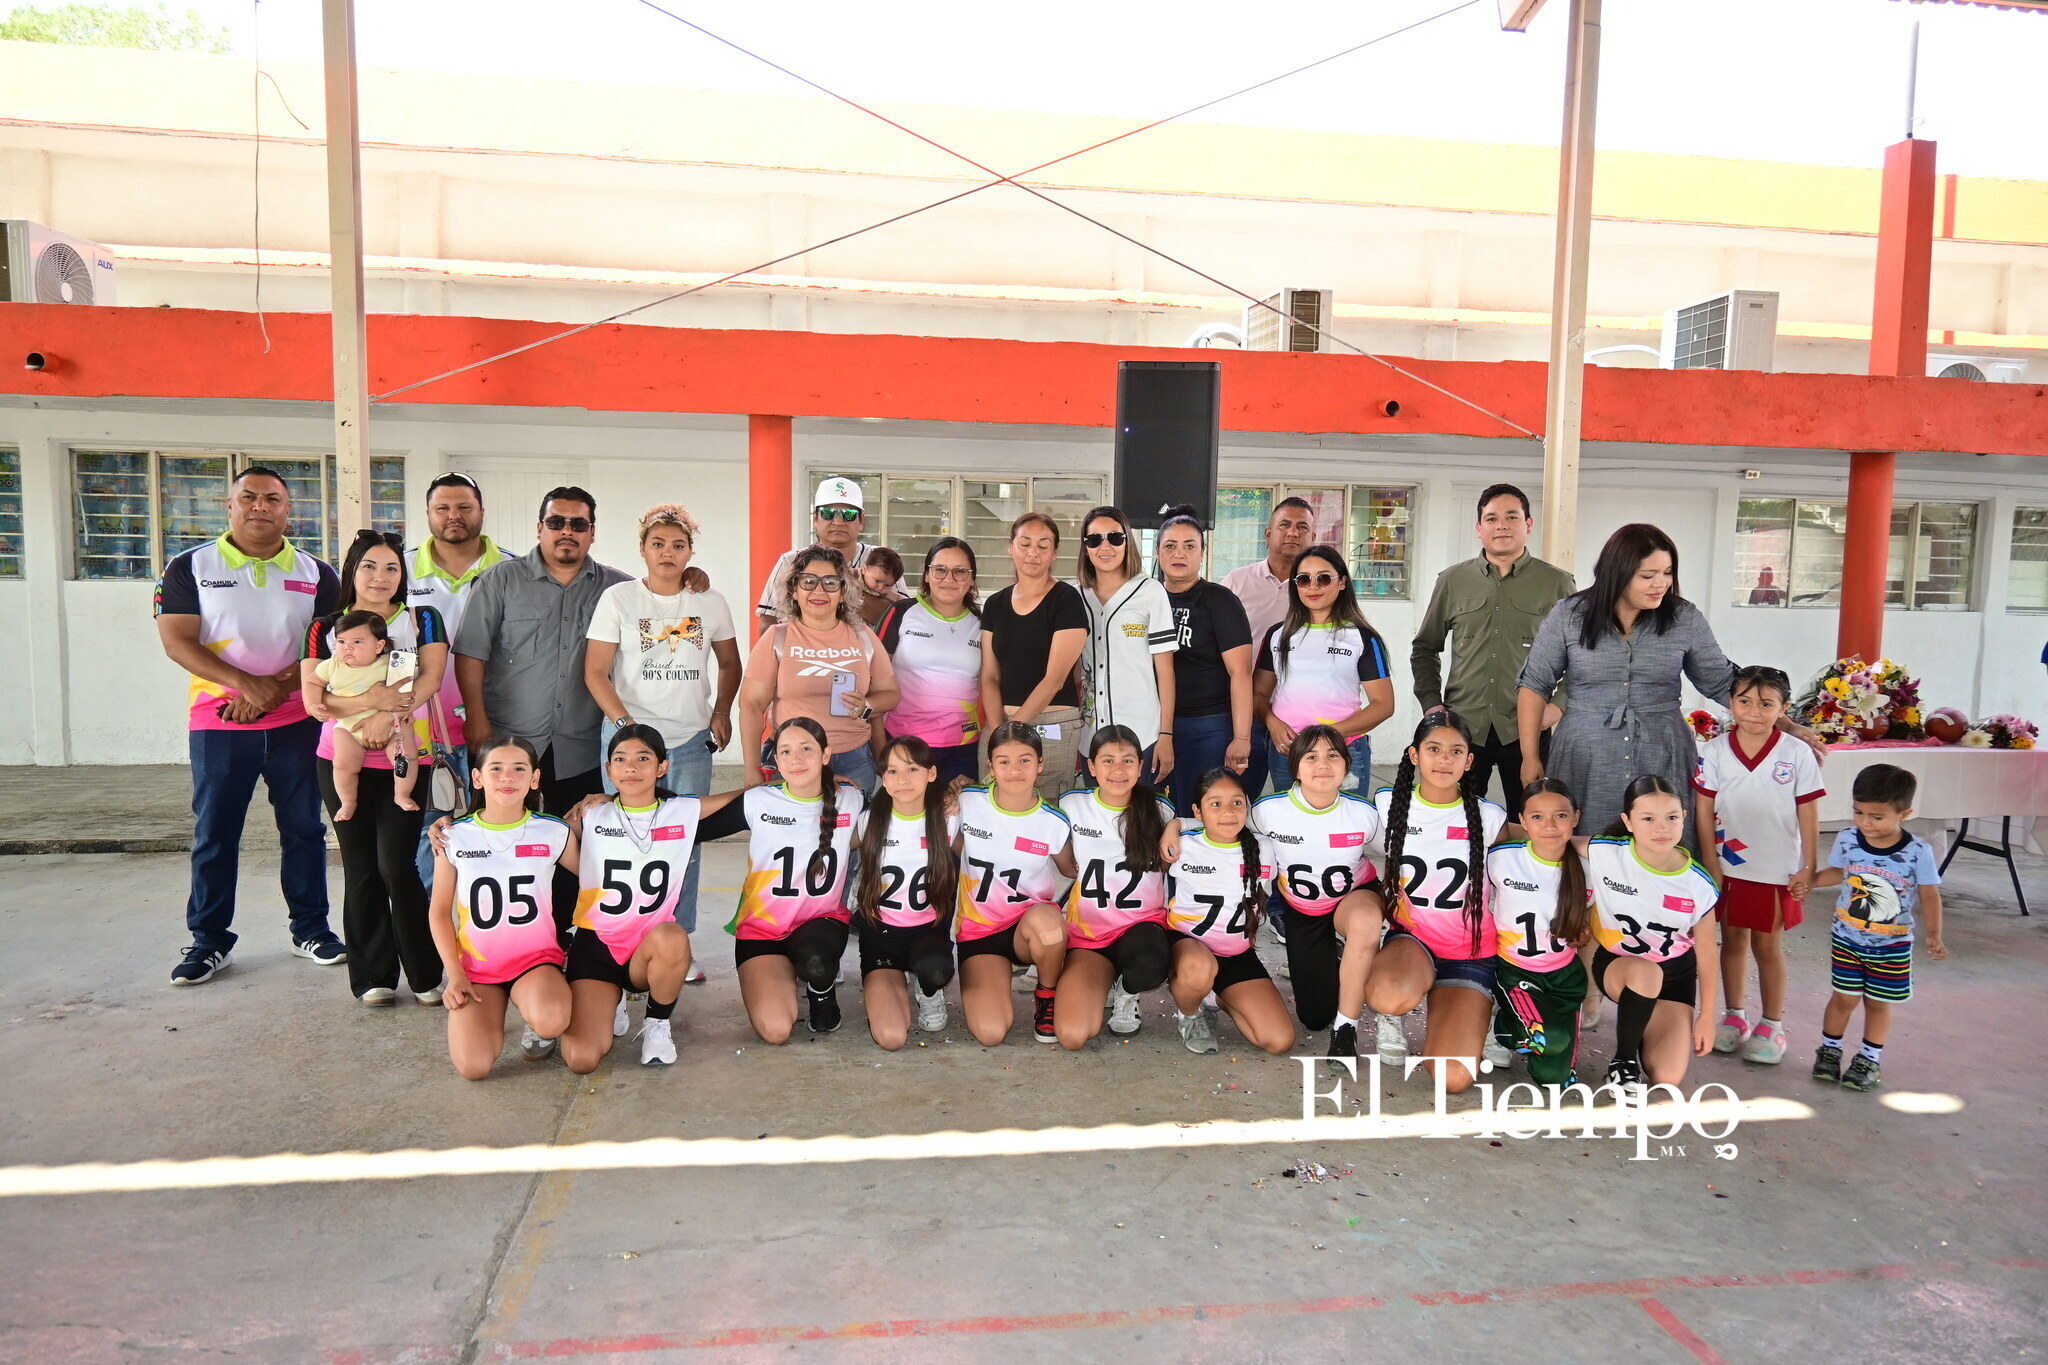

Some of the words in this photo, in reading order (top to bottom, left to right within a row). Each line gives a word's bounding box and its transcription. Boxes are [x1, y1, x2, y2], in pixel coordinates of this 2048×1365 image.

[98, 259, 114, 271] AUX
[1121, 623, 1148, 632] LOONEY
[790, 646, 862, 659] Reebok
[1327, 646, 1353, 657] ROCIO
[641, 658, 674, 669] Raised
[760, 813, 797, 823] COAHUILA
[963, 822, 993, 838] COAHUILA
[1072, 823, 1103, 836] COAHUILA
[1268, 830, 1304, 842] COAHUILA
[1031, 841, 1047, 850] SEDU
[456, 849, 492, 859] COAHUILA
[772, 846, 838, 897] 10
[1181, 863, 1217, 873] COAHUILA
[600, 858, 670, 915] 59
[968, 856, 1031, 903] 71
[1081, 858, 1142, 909] 42
[1286, 863, 1355, 901] 60
[1399, 854, 1468, 910] 22
[1503, 878, 1539, 891] COAHUILA
[1603, 876, 1639, 894] COAHUILA
[880, 864, 931, 911] 26
[469, 874, 539, 930] 05
[1190, 893, 1249, 940] 74
[1613, 913, 1680, 957] 37
